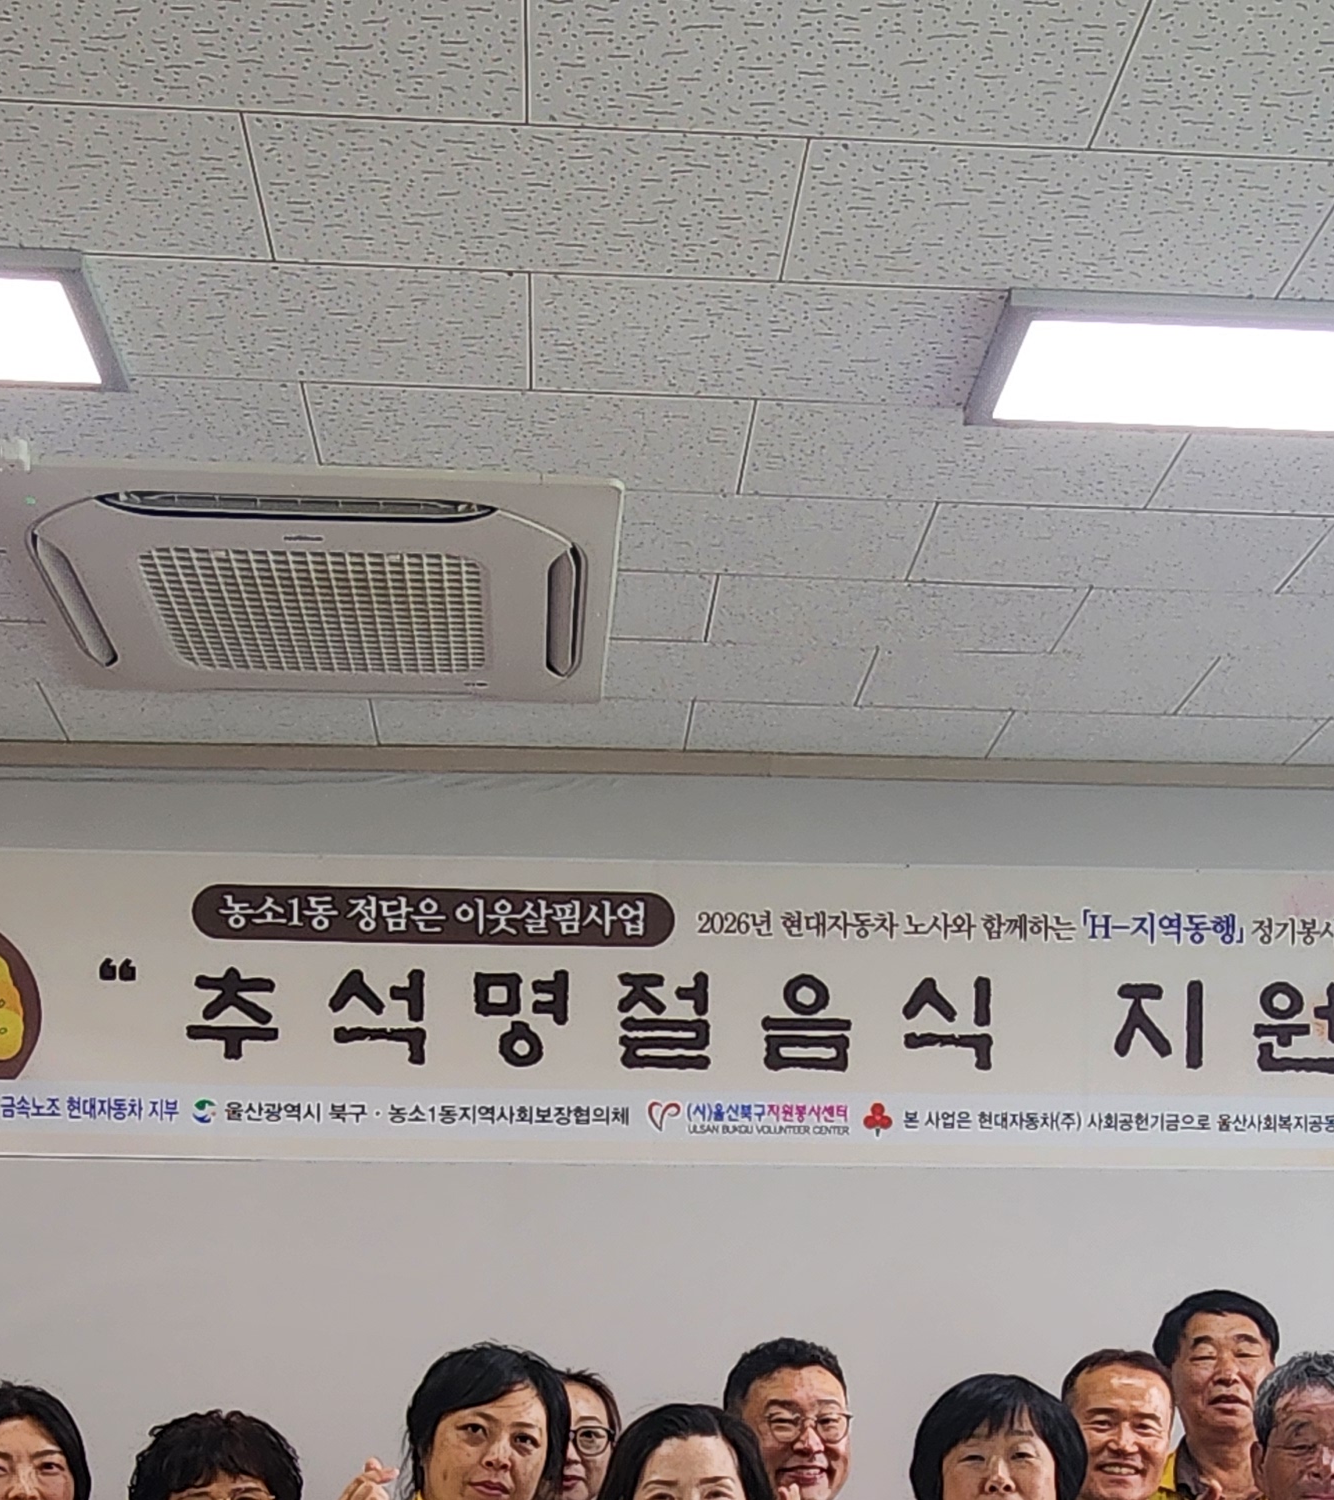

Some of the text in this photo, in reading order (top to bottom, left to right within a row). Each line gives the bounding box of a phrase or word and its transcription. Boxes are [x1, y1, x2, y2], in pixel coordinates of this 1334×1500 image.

[219, 895, 646, 937] 농소1동 정담은 이웃살핌사업
[697, 910, 773, 936] 2026년
[780, 910, 899, 939] 현대자동차
[903, 912, 977, 941] 노사와
[980, 913, 1076, 941] 함께하는
[0, 1095, 179, 1120] 금속노조 현대자동차 지부
[224, 1101, 321, 1123] 울산광역시
[328, 1102, 367, 1123] 북구
[387, 1103, 629, 1126] 농소1동지역사회보장협의체
[688, 1124, 849, 1136] ULSAN BUKGU VOLUNTEER CENTER
[903, 1110, 918, 1129] 본
[924, 1110, 972, 1130] 사업은
[978, 1111, 1082, 1132] 현대자동차(주)
[1087, 1112, 1211, 1132] 사회공헌기금으로
